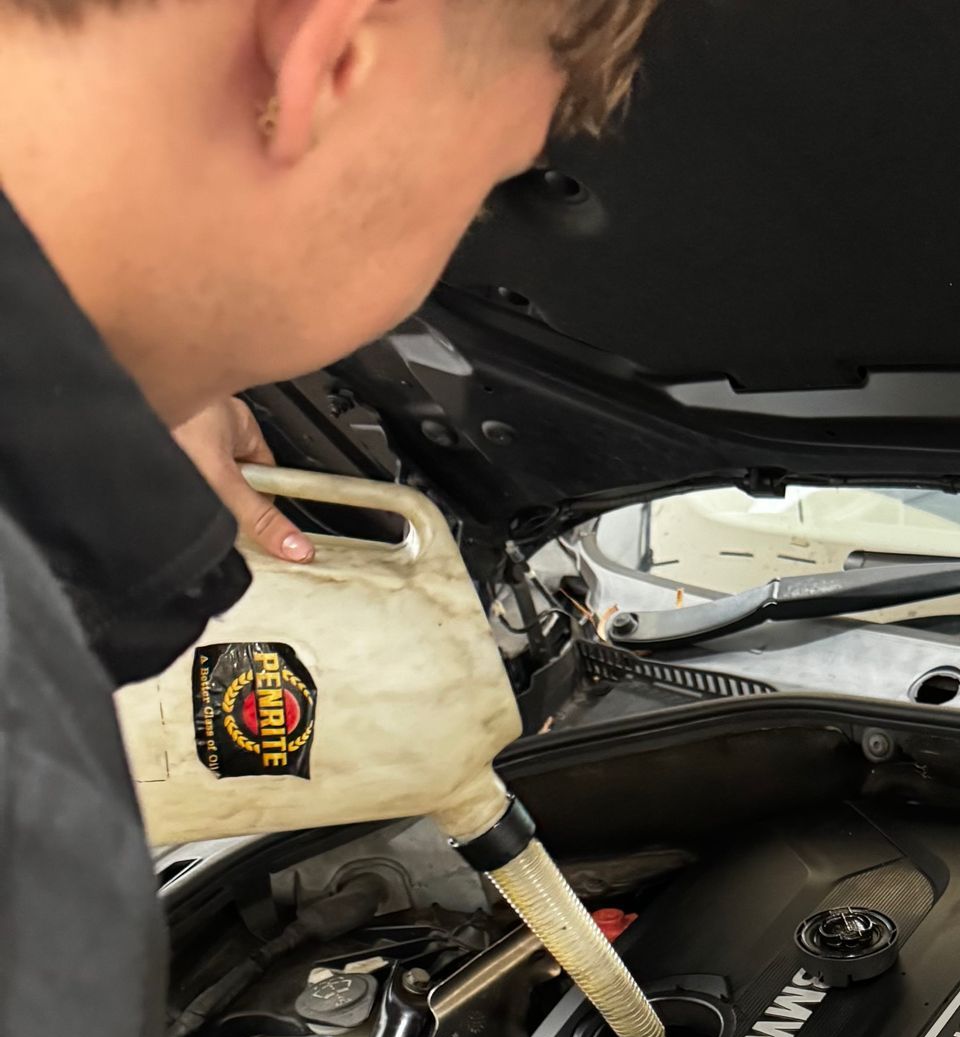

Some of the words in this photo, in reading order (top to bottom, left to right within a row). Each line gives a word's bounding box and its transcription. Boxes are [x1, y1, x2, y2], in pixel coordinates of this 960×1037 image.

[199, 654, 209, 664] A
[200, 667, 211, 703] Better
[203, 706, 215, 737] Class
[253, 652, 288, 767] PENRITE
[206, 739, 218, 753] of
